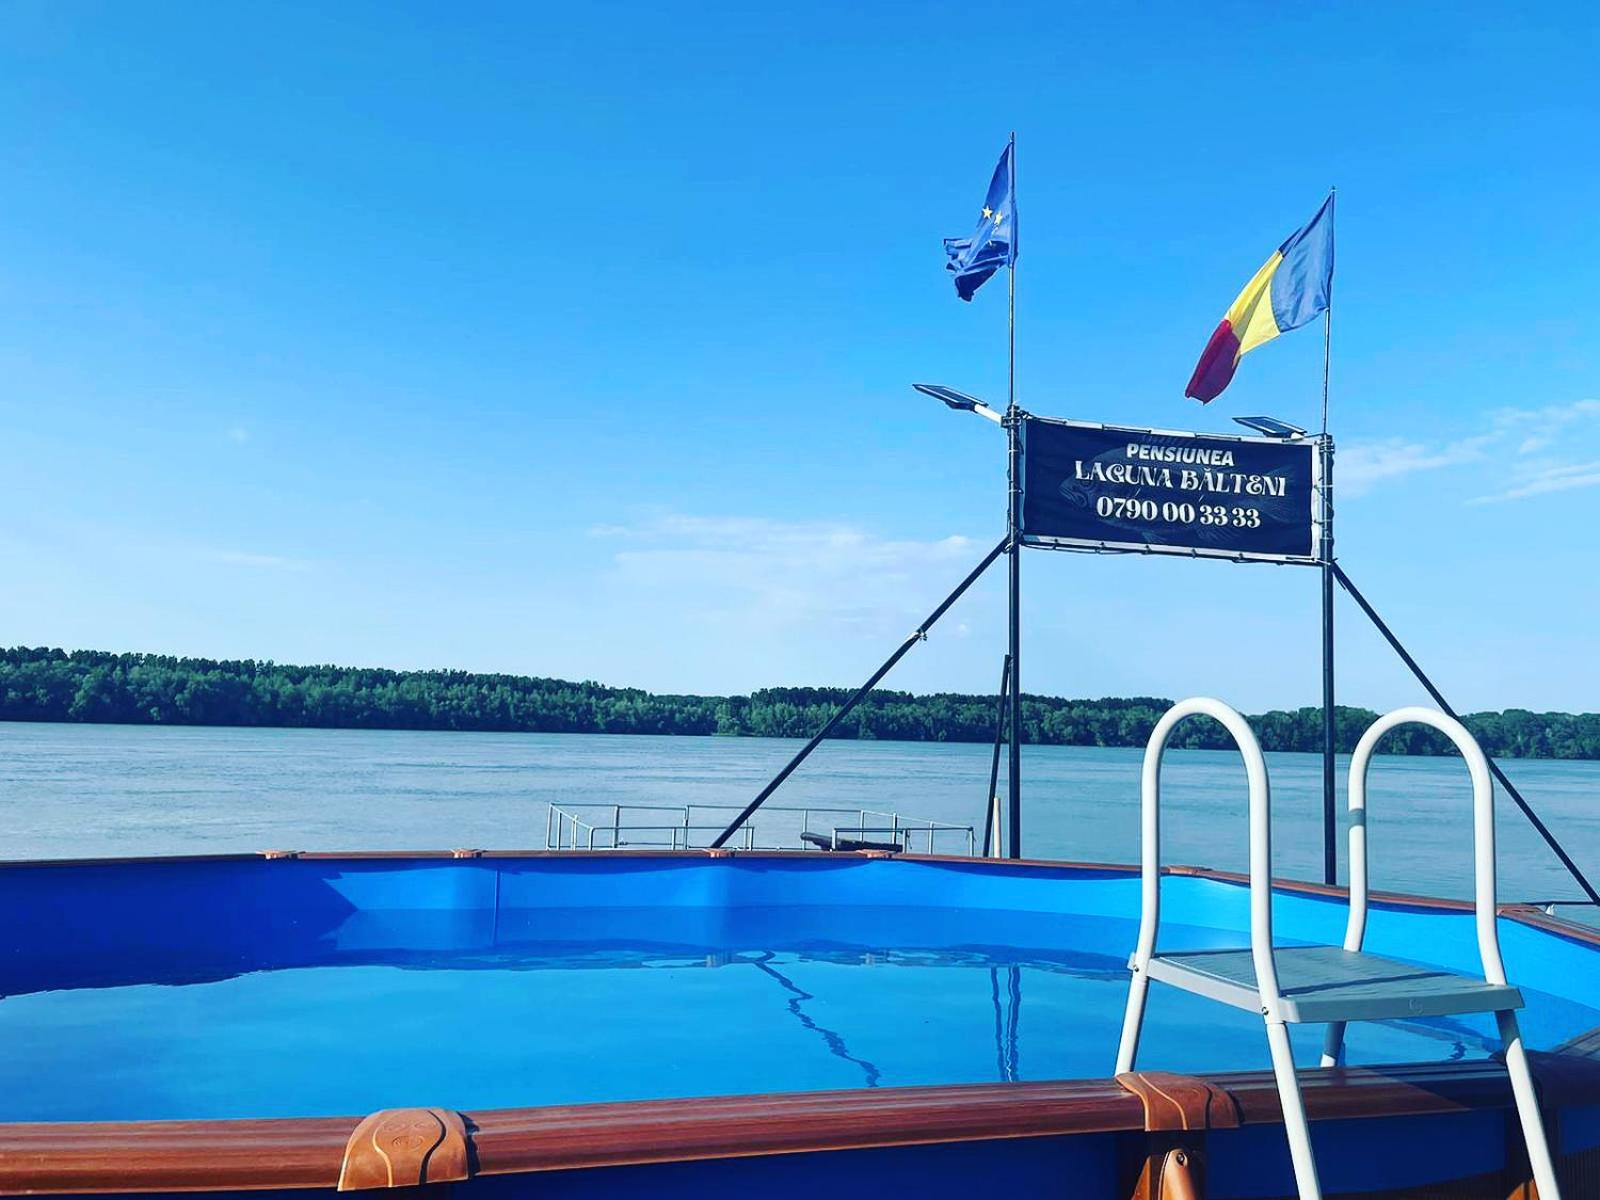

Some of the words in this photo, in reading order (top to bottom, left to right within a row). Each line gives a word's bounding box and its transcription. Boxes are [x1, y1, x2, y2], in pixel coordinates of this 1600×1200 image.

[1127, 443, 1235, 467] PENSIUNEA
[1075, 461, 1173, 488] LAGUNA
[1180, 468, 1286, 496] BĂLTENI
[1096, 496, 1158, 521] 0790
[1162, 502, 1196, 523] 00
[1200, 505, 1228, 526] 33
[1232, 508, 1261, 529] 33
